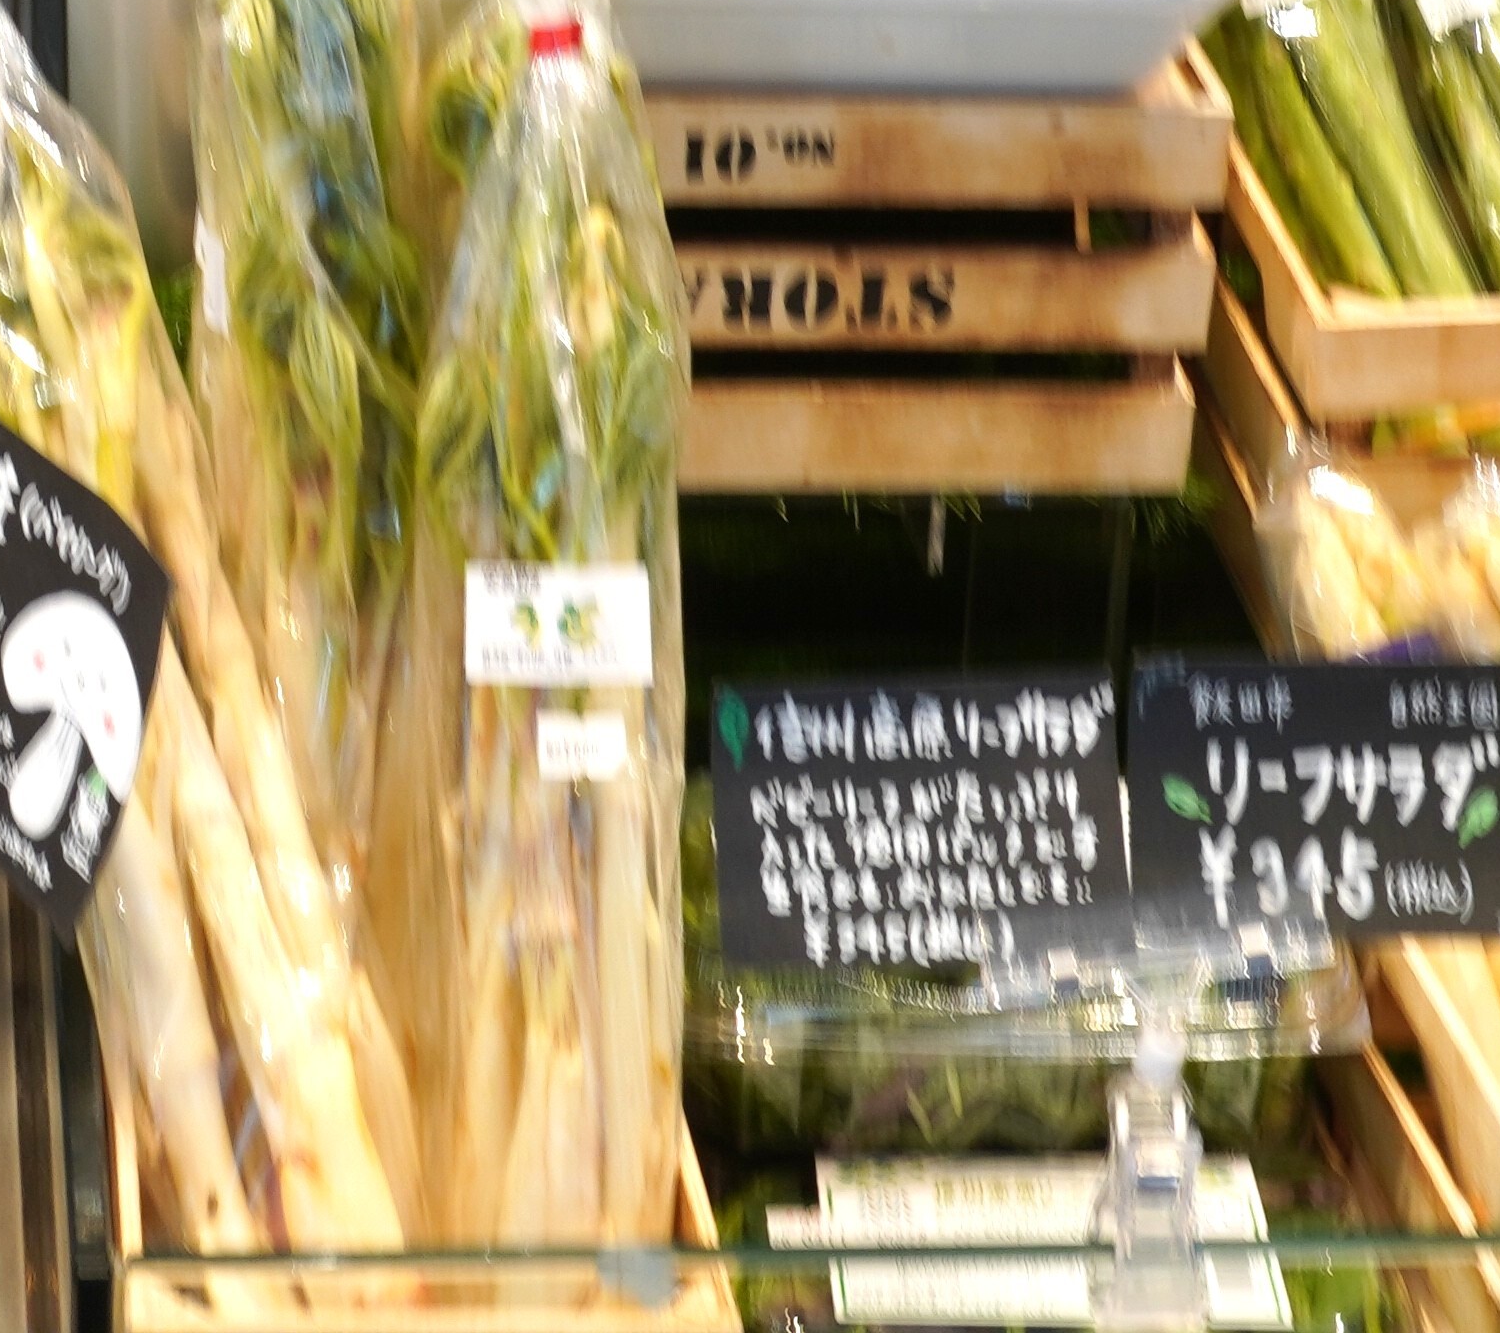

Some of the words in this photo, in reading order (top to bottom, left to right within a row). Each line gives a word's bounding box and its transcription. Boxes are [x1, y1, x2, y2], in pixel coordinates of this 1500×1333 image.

[1206, 733, 1500, 832] リーフサラダ
